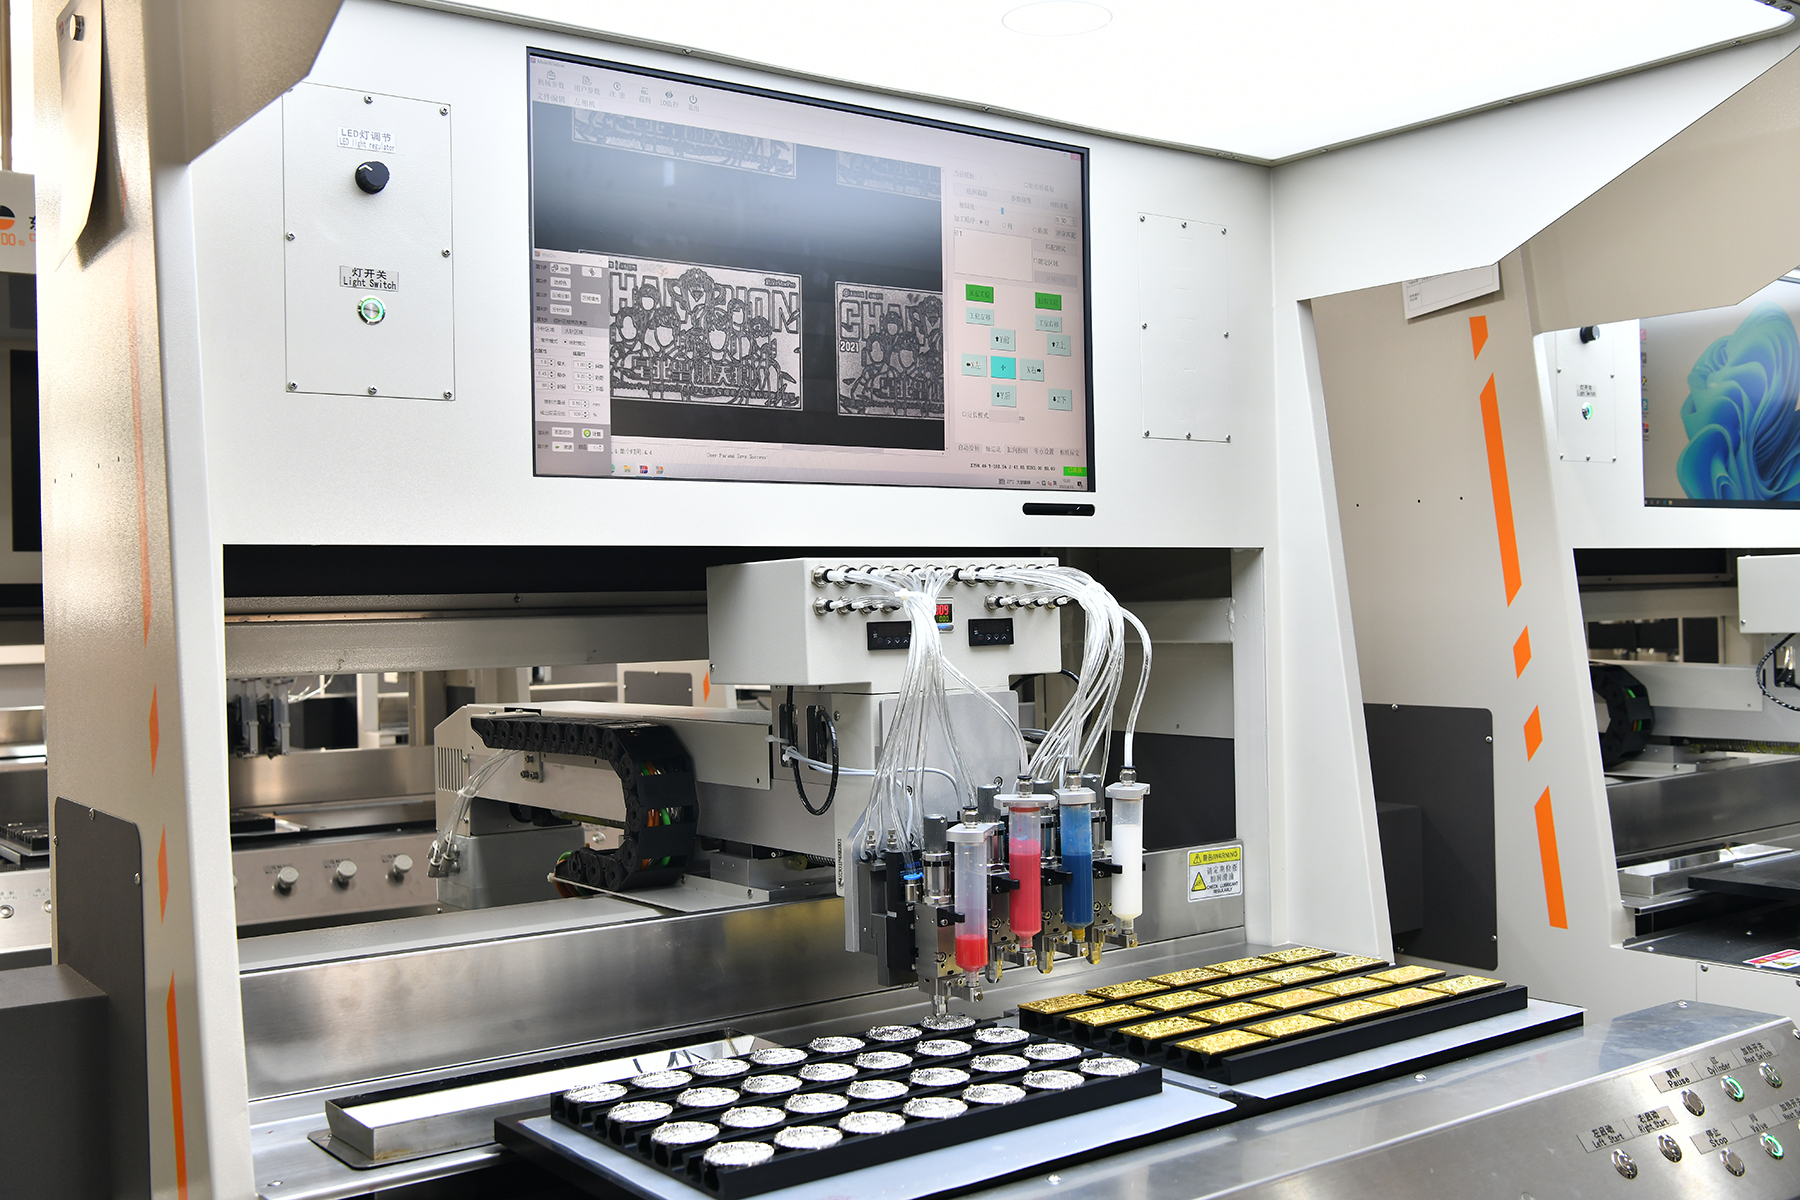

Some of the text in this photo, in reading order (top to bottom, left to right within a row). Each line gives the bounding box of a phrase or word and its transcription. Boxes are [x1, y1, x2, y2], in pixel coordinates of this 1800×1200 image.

[351, 267, 387, 280] 灯开关
[343, 275, 397, 290] Light Switch
[839, 341, 860, 353] 2021
[1706, 1062, 1732, 1076] Cylinder
[1666, 1076, 1691, 1089] Pause
[1637, 1110, 1660, 1124] 右启动
[1591, 1124, 1615, 1139] 左启动
[1637, 1118, 1670, 1134] Right Start
[1749, 1122, 1769, 1133] Valve
[1591, 1133, 1625, 1149] Left Start
[1709, 1136, 1729, 1148] Stop
